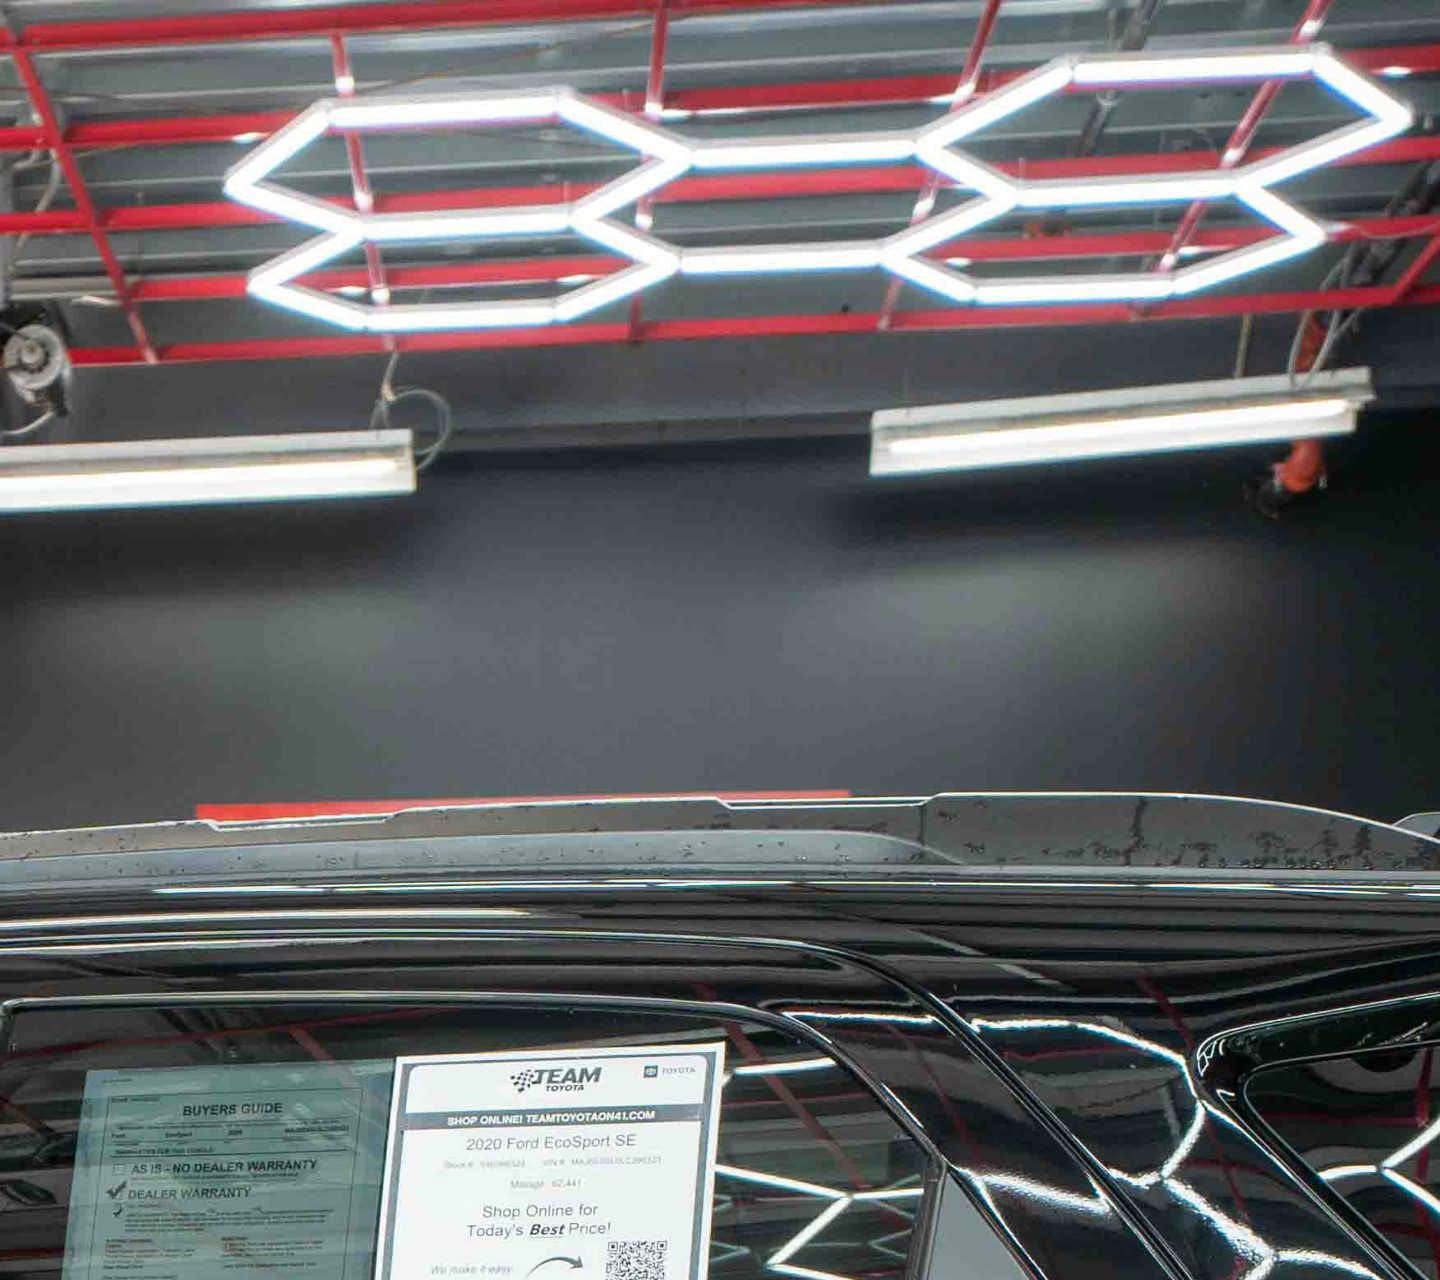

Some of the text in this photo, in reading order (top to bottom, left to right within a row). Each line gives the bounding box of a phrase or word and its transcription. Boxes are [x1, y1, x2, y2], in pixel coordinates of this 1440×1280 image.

[532, 1066, 602, 1085] TEAM
[663, 1066, 696, 1075] TOYOTA
[546, 1083, 585, 1092] TOYOTA
[182, 1102, 283, 1116] BUYERS GUIDE
[448, 1110, 656, 1127] SHOP ONLINE! TEAMTOYOTAON41.COM
[466, 1133, 637, 1152] 2020 Ford EcoSport SE
[131, 1163, 148, 1175] AS
[150, 1163, 162, 1174] IS
[173, 1163, 191, 1174] NO
[194, 1161, 245, 1173] DEALER
[248, 1159, 317, 1172] WARRANTY
[128, 1186, 253, 1200] DEALER WARRANTY
[482, 1203, 598, 1220] Shop Online for
[466, 1221, 612, 1239] Today's Best Price!
